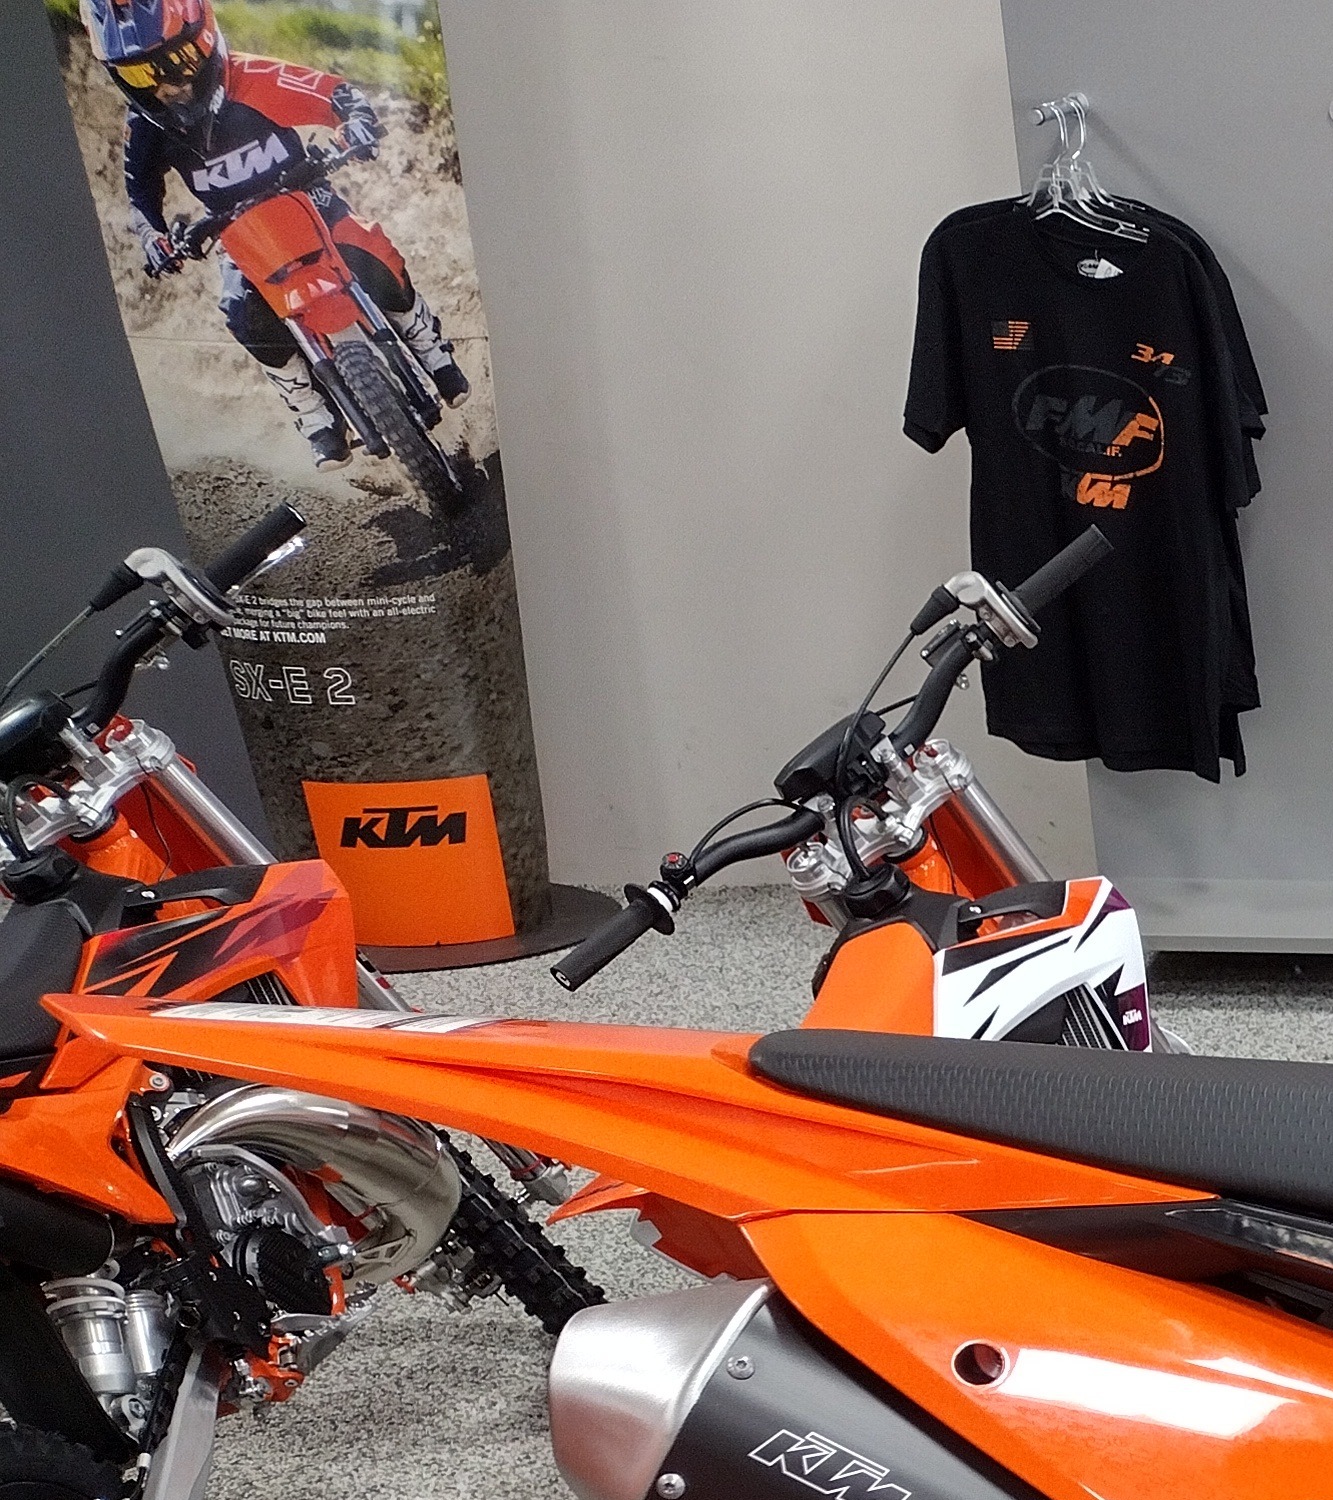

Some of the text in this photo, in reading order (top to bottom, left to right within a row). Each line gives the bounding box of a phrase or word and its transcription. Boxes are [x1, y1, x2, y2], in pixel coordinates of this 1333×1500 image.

[192, 132, 290, 192] KTM
[325, 595, 364, 607] between
[366, 594, 416, 606] mini-cycle
[418, 593, 436, 603] and
[306, 608, 327, 618] bike
[328, 608, 347, 618] feel
[348, 608, 370, 618] with
[372, 608, 385, 617] an
[386, 605, 437, 616] all-electric
[297, 620, 350, 630] champions.
[233, 627, 259, 641] MORE
[259, 630, 271, 642] AT
[272, 631, 327, 644] KTM.COM
[229, 659, 357, 705] SX-E 2
[340, 804, 467, 848] KTM
[1122, 1008, 1143, 1026] KTM
